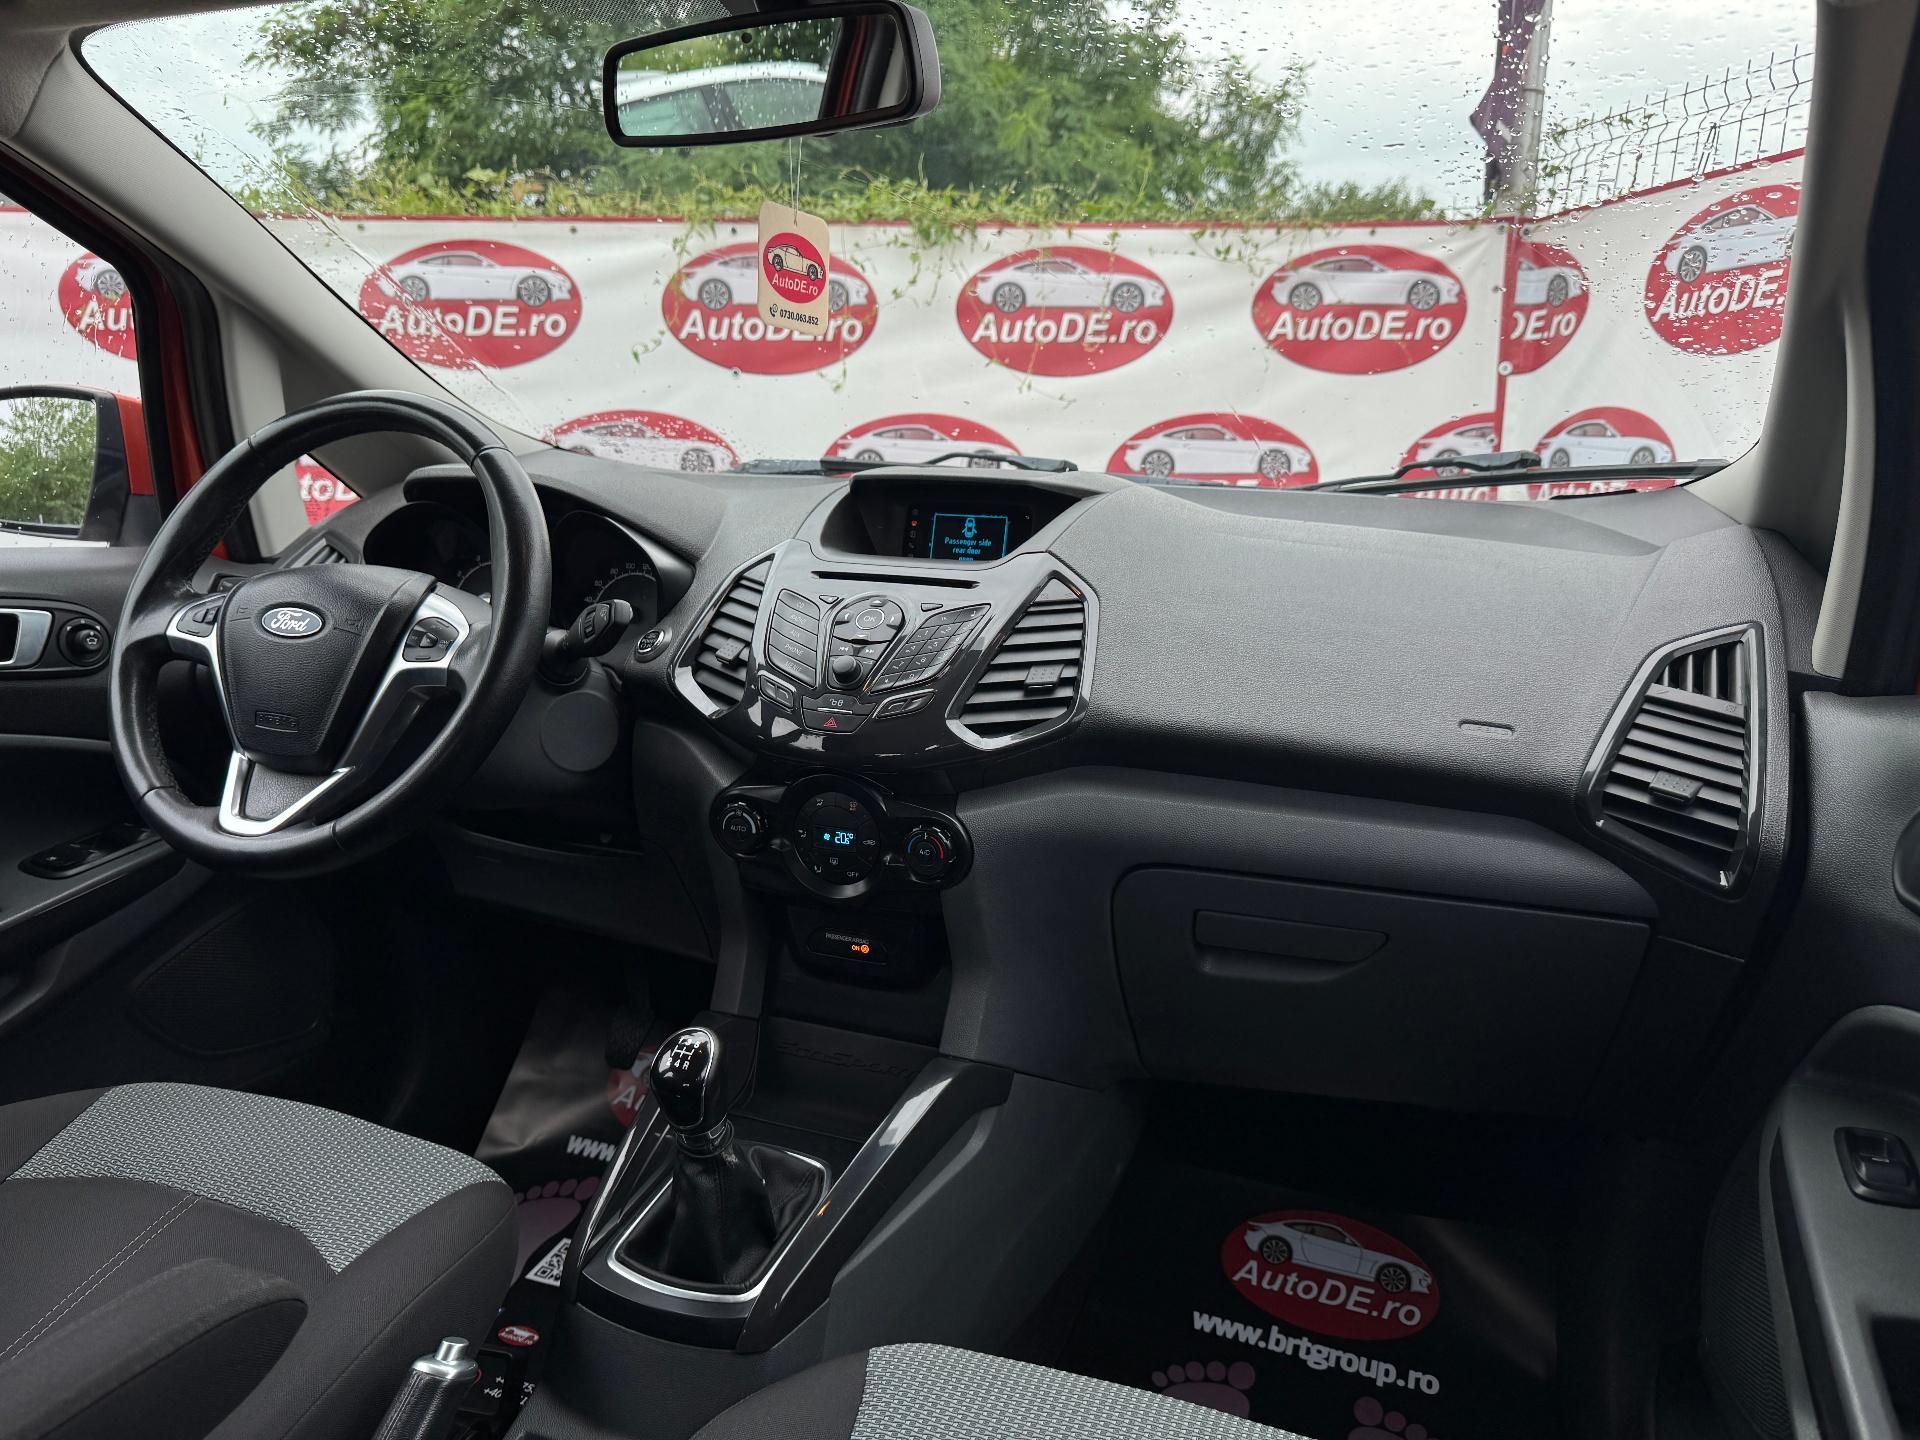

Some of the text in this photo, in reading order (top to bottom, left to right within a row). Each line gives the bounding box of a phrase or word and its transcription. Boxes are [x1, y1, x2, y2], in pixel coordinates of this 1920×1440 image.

[772, 273, 818, 296] AutoDE.ro
[79, 299, 134, 331] Au
[379, 304, 567, 337] AutoDE.ro
[680, 309, 863, 342] Auto.ro
[779, 308, 819, 326] 0730.063.852
[1267, 311, 1451, 341] AutoDE.ro
[971, 312, 1158, 344] AutoDE.ro
[944, 536, 992, 547] Passenger side
[952, 546, 981, 555] rear door
[270, 609, 310, 632] Ford
[863, 614, 877, 623] OK
[784, 643, 804, 657] PHONE
[730, 824, 747, 832] AUTO
[682, 1060, 690, 1070] R
[1232, 1259, 1422, 1328] AutoDE.ro
[1192, 1310, 1441, 1396] www.brtgroup.ro
